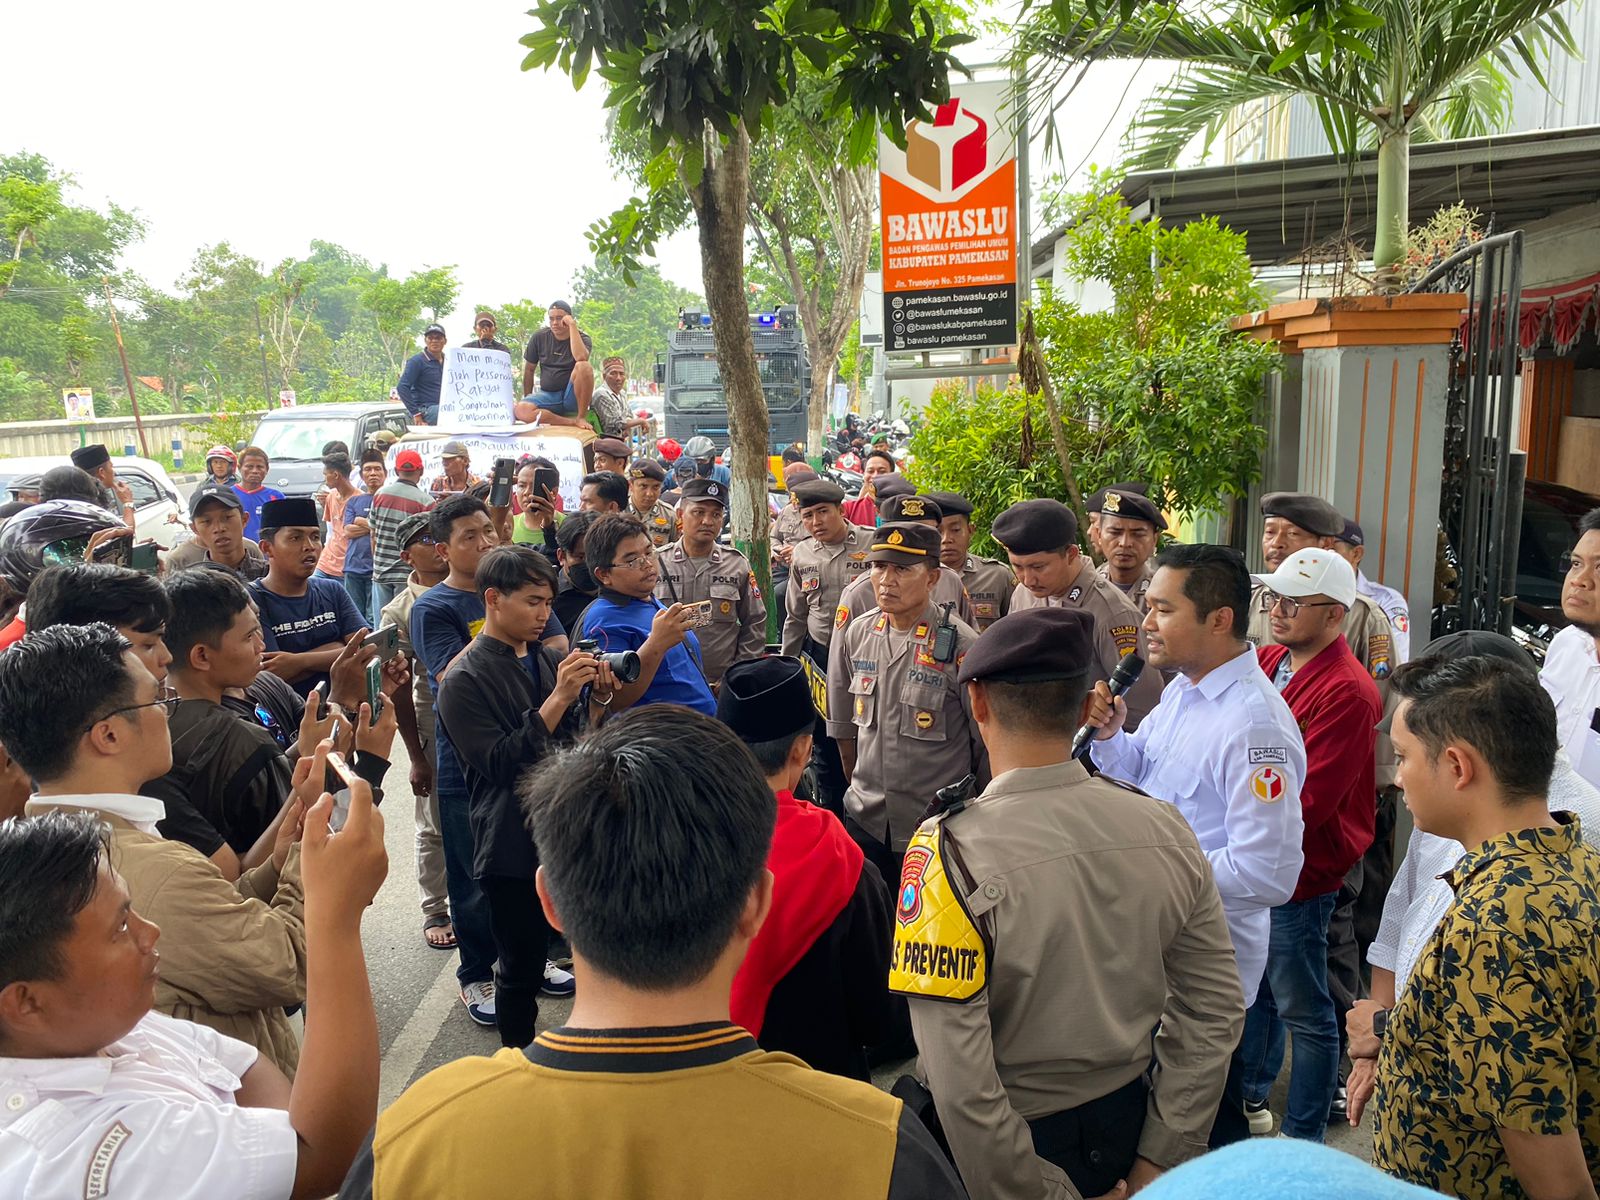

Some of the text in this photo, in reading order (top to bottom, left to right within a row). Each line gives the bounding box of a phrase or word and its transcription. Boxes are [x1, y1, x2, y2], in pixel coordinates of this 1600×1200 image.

[887, 206, 1008, 242] BAWASLU
[888, 238, 1009, 255] BADAN PENGAWAS PEMILIHAN UMUM
[888, 249, 1009, 269] KABUPATEN PAMEKASAN
[894, 273, 1005, 288] Jln. Trunojoyo No. 325 Pamekasan
[905, 290, 1008, 306] pamekasan.bawaslu.go.id
[906, 306, 983, 320] @bawaslumekasan
[906, 318, 1008, 334] @bawaslukabpamekasan
[906, 335, 940, 345] bawaslu
[941, 332, 987, 344] pamekasan
[846, 561, 872, 570] POLR
[712, 575, 738, 584] POLRI
[970, 592, 995, 600] POLRI
[908, 669, 943, 687] POLRI
[903, 941, 979, 981] PREVENTIF
[89, 1128, 124, 1196] SEKRETARIAT
